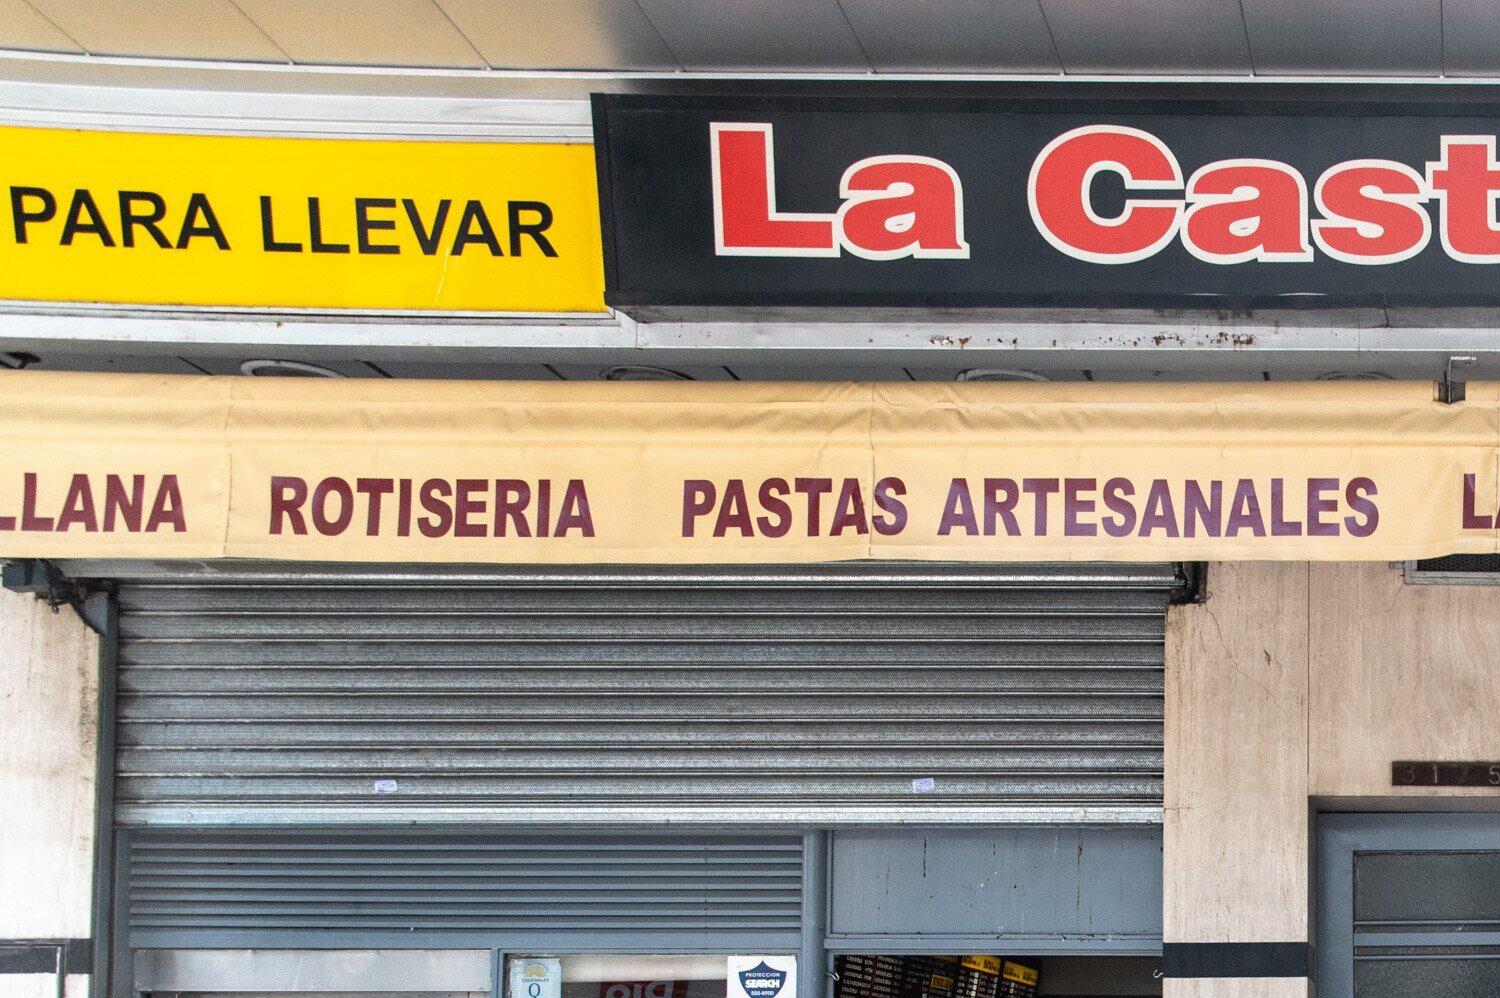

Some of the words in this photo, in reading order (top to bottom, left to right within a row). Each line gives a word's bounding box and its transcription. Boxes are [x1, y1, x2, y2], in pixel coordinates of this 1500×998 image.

[9, 185, 231, 251] PARA
[259, 196, 559, 258] LLEVAR
[710, 122, 970, 261] La
[269, 476, 596, 538] ROTISERIA
[681, 477, 908, 538] PASTAS
[937, 476, 1381, 539] ARTESANALES
[745, 979, 780, 989] SEARCH
